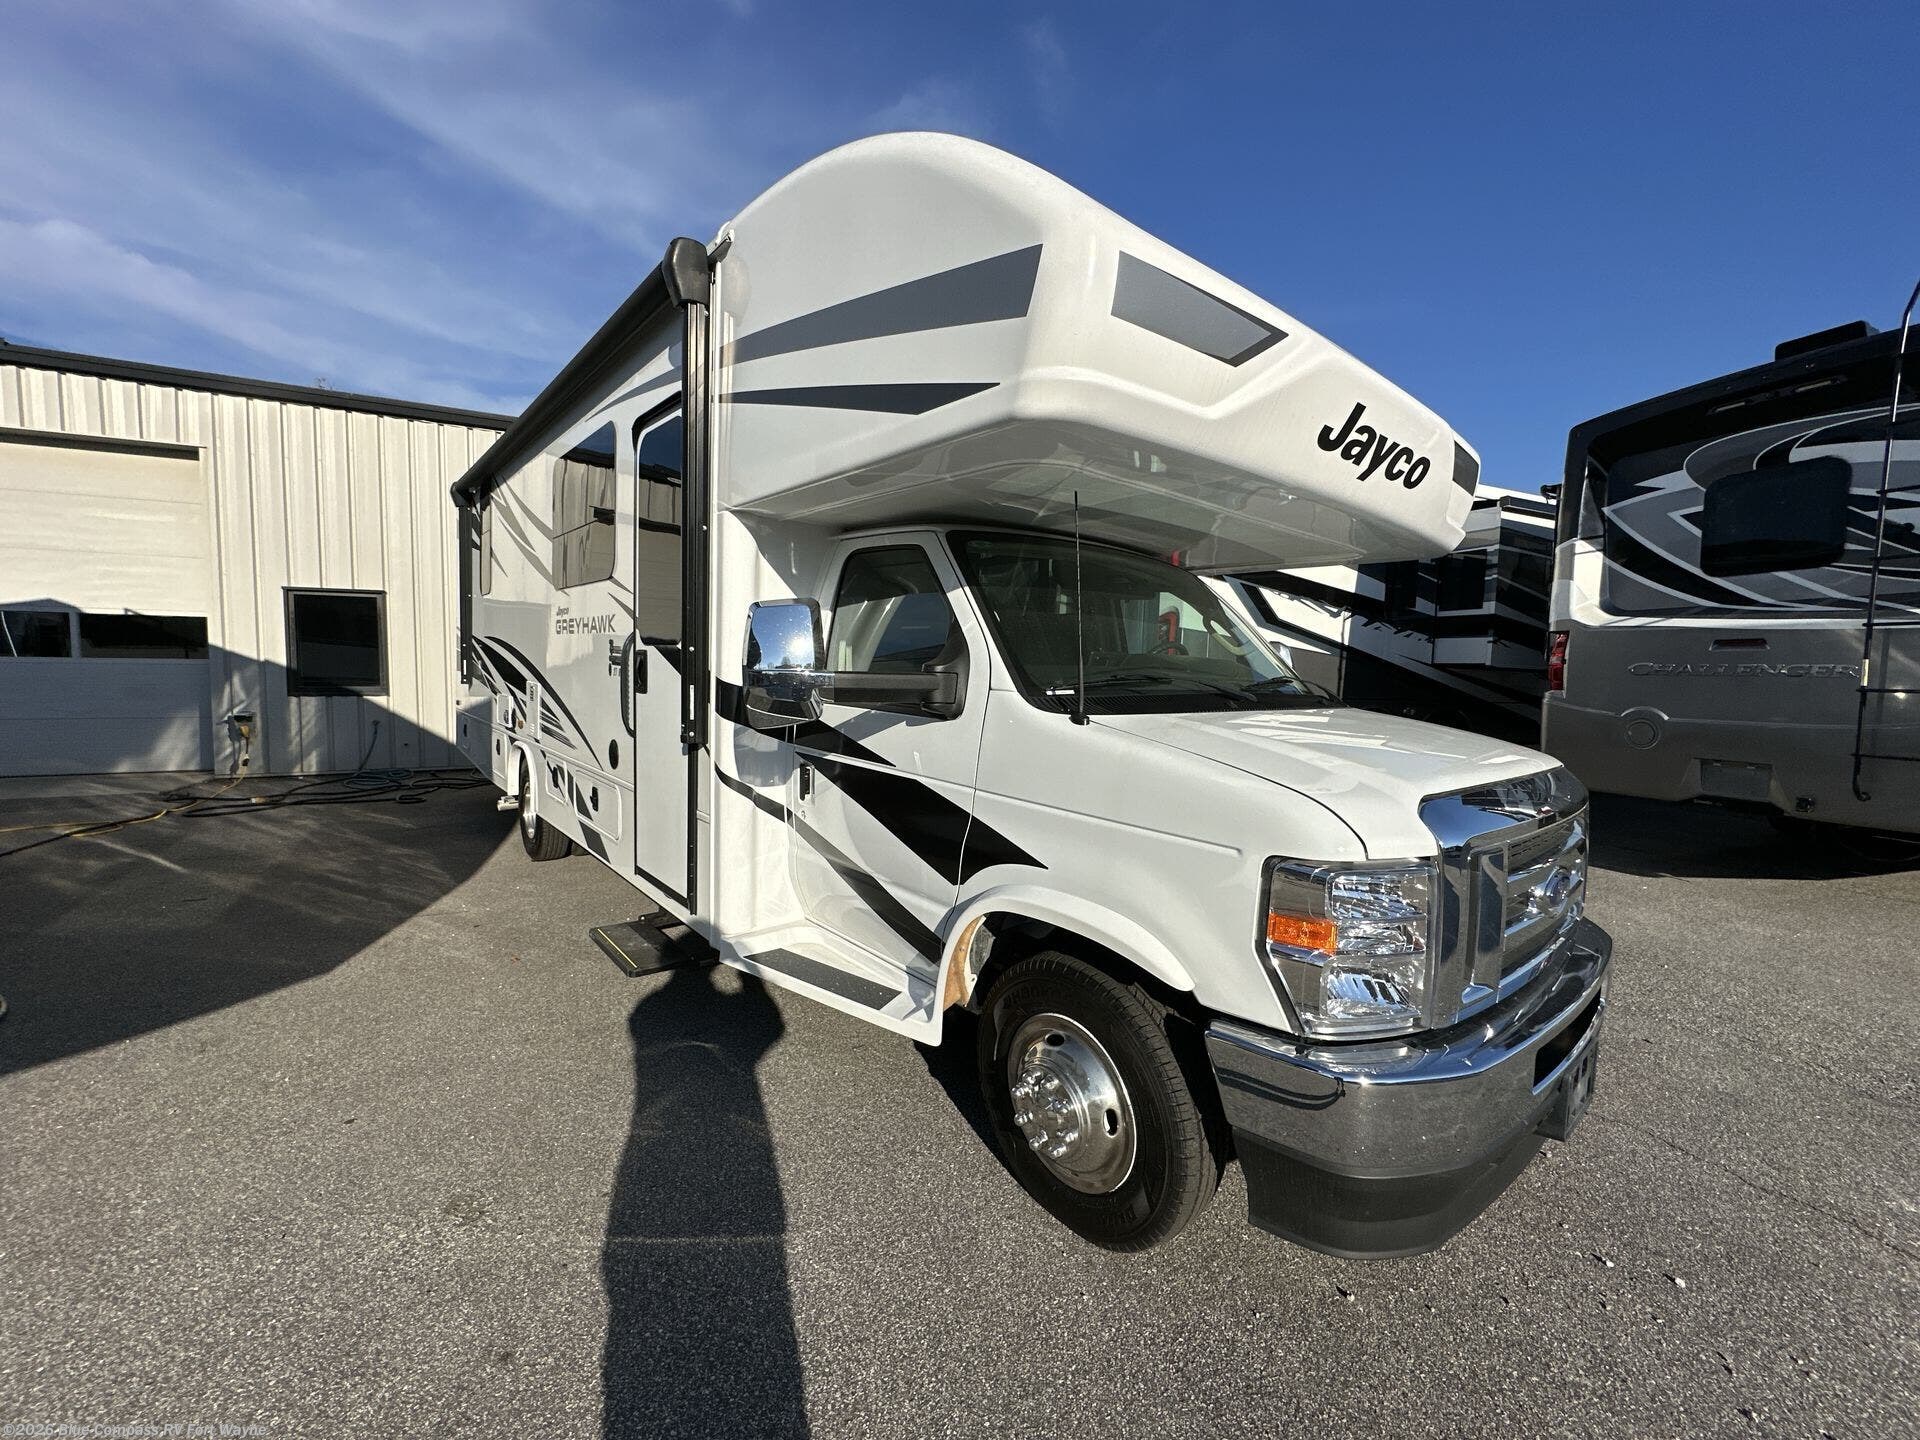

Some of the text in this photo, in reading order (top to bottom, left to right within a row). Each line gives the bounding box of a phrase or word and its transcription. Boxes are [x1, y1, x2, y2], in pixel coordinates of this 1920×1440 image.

[1317, 402, 1431, 490] Jayco
[556, 614, 616, 635] GREYHAWK
[1627, 661, 1860, 678] CHALLENGER
